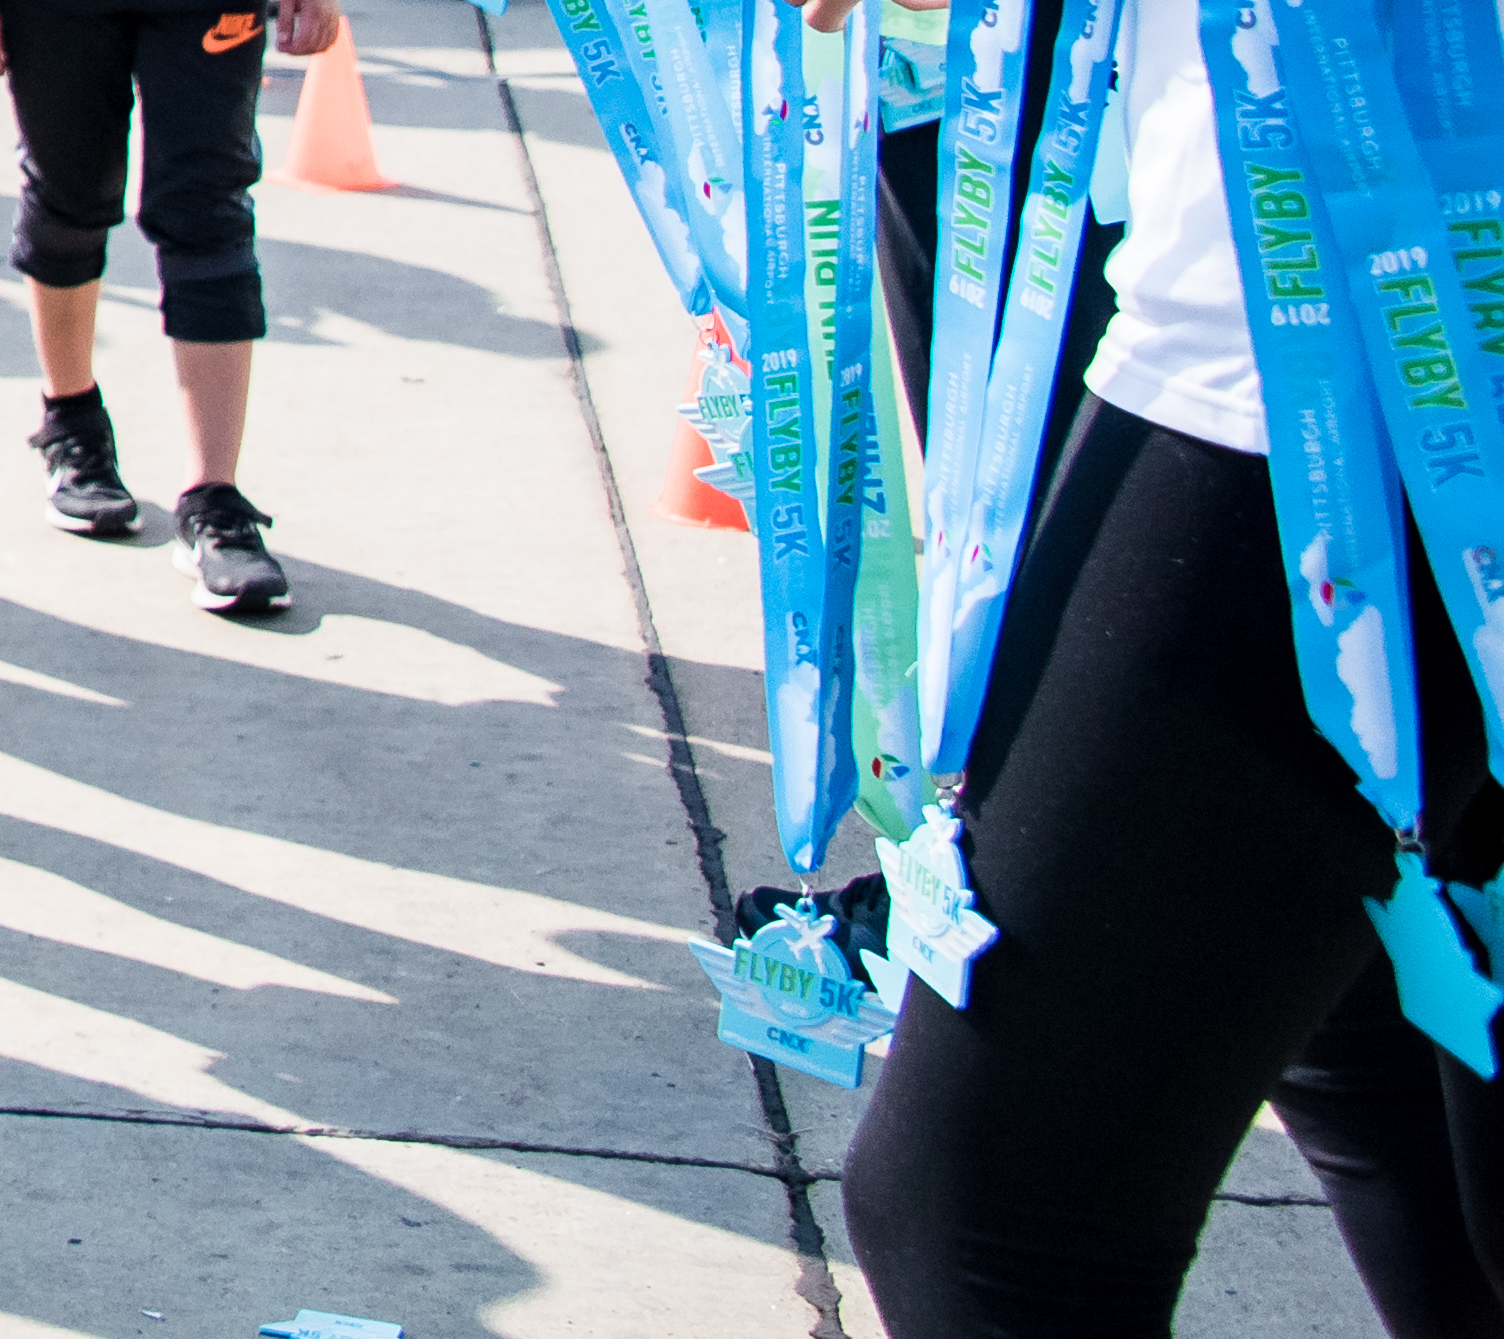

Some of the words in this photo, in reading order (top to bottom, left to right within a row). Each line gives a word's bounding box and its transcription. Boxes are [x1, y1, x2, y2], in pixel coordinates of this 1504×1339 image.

[582, 37, 624, 90] 5K
[803, 94, 824, 146] CNX
[958, 75, 1005, 146] 5K
[1233, 84, 1295, 152] 5K
[1331, 35, 1383, 173] PITTSBURGH
[774, 162, 788, 279] PITTSBURGH
[951, 141, 995, 282] FLYBY
[1025, 156, 1076, 295] FLYBY
[1054, 88, 1092, 157] 5K
[1244, 161, 1326, 301] FLYBY
[1368, 245, 1429, 278] 2019
[948, 273, 987, 310] 2019
[1019, 287, 1056, 320] 2019
[1271, 301, 1331, 327] 2019
[761, 348, 797, 373] 2019
[1376, 273, 1469, 411] FLYBY
[698, 394, 740, 421] FLYBY
[763, 372, 805, 494] FLYBY
[836, 386, 864, 507] FLYBY
[980, 384, 1018, 506] PITTSBURGH
[1420, 420, 1486, 494] 5K
[772, 503, 811, 563] 5K
[899, 848, 941, 907] FLYBY
[940, 882, 964, 925] 5K
[735, 948, 815, 1000] FLYBY
[819, 976, 864, 1016] 5K
[767, 1026, 809, 1054] CNX
